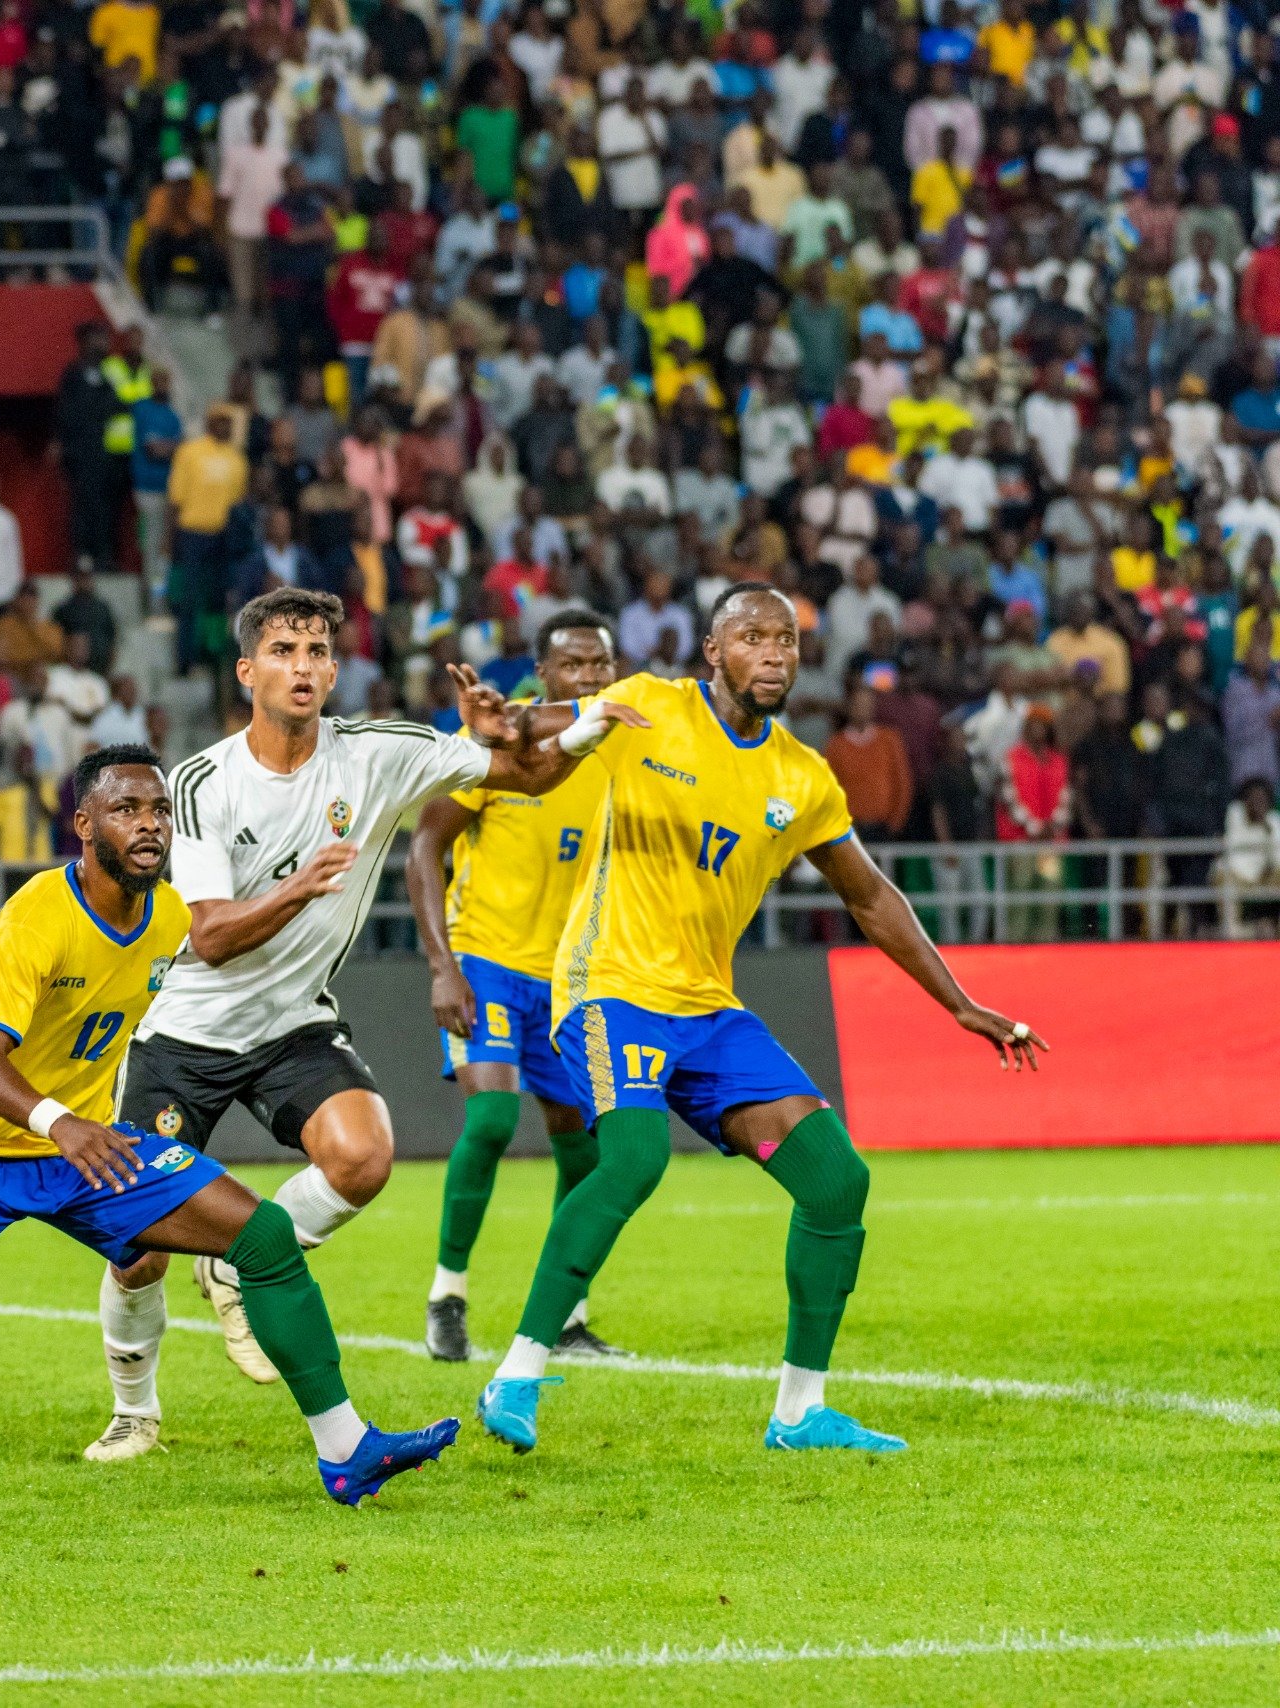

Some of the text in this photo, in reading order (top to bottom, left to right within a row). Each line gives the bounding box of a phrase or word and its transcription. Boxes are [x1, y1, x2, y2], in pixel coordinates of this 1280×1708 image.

[558, 827, 583, 862] 5
[696, 820, 741, 878] 17
[68, 1010, 126, 1062] 12
[485, 1001, 512, 1039] 5
[622, 1043, 667, 1082] 17
